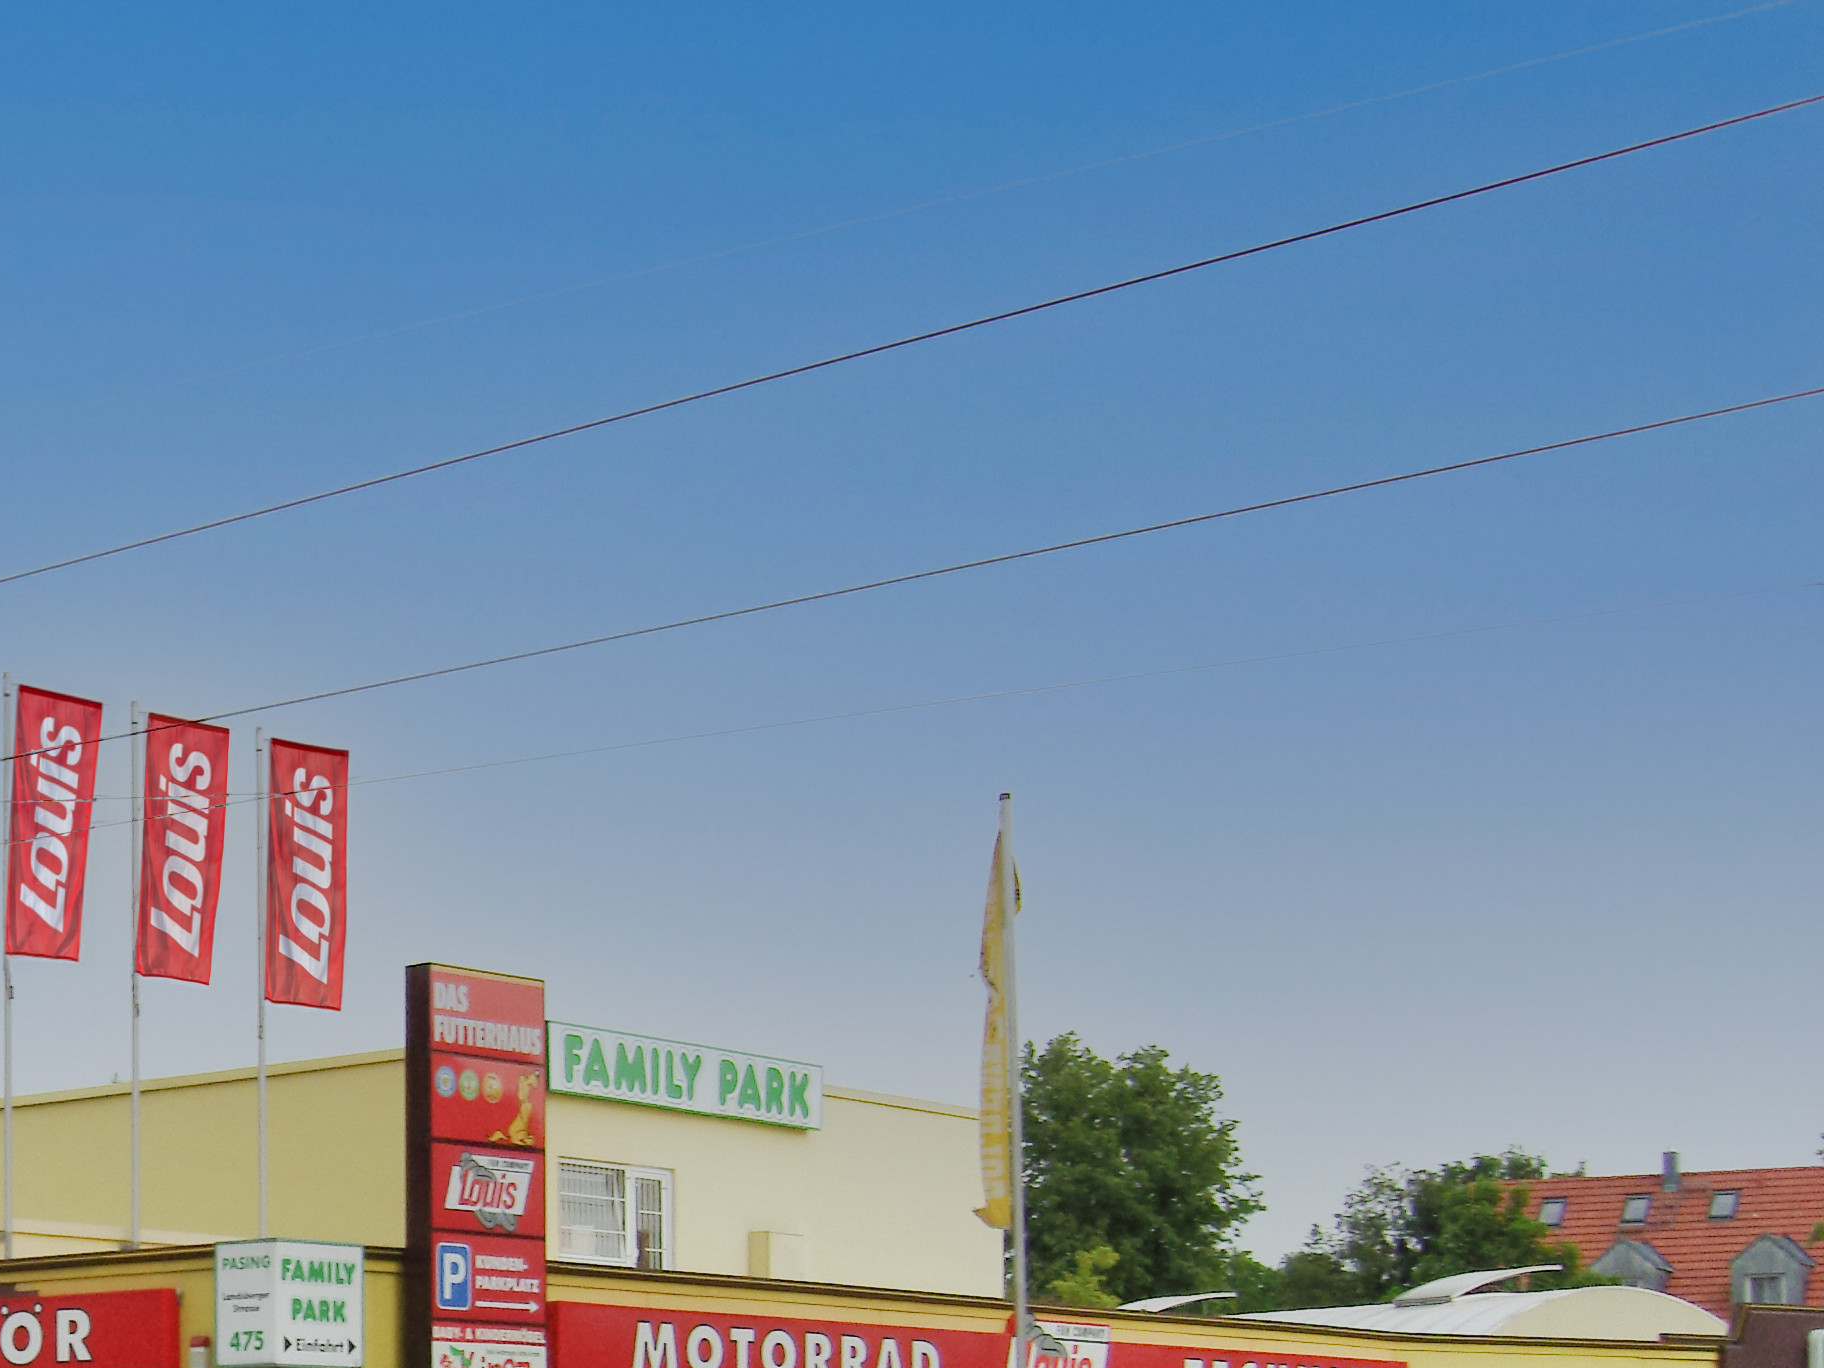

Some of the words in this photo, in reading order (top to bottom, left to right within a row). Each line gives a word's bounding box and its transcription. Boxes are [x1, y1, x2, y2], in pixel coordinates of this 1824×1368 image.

[20, 716, 82, 933] Louis
[150, 743, 212, 958] Louis
[278, 767, 334, 985] Louis
[433, 981, 469, 1012] DAS
[433, 1014, 542, 1056] FUTTERHAUS
[564, 1033, 702, 1101] FAMILY
[719, 1059, 809, 1120] PARK
[458, 1168, 517, 1210] Louis
[223, 1255, 271, 1270] PASING
[281, 1258, 355, 1285] FAMILY
[443, 1252, 467, 1300] P
[292, 1298, 346, 1323] PARK
[229, 1330, 264, 1351] 475
[296, 1338, 344, 1352] Einfahrt
